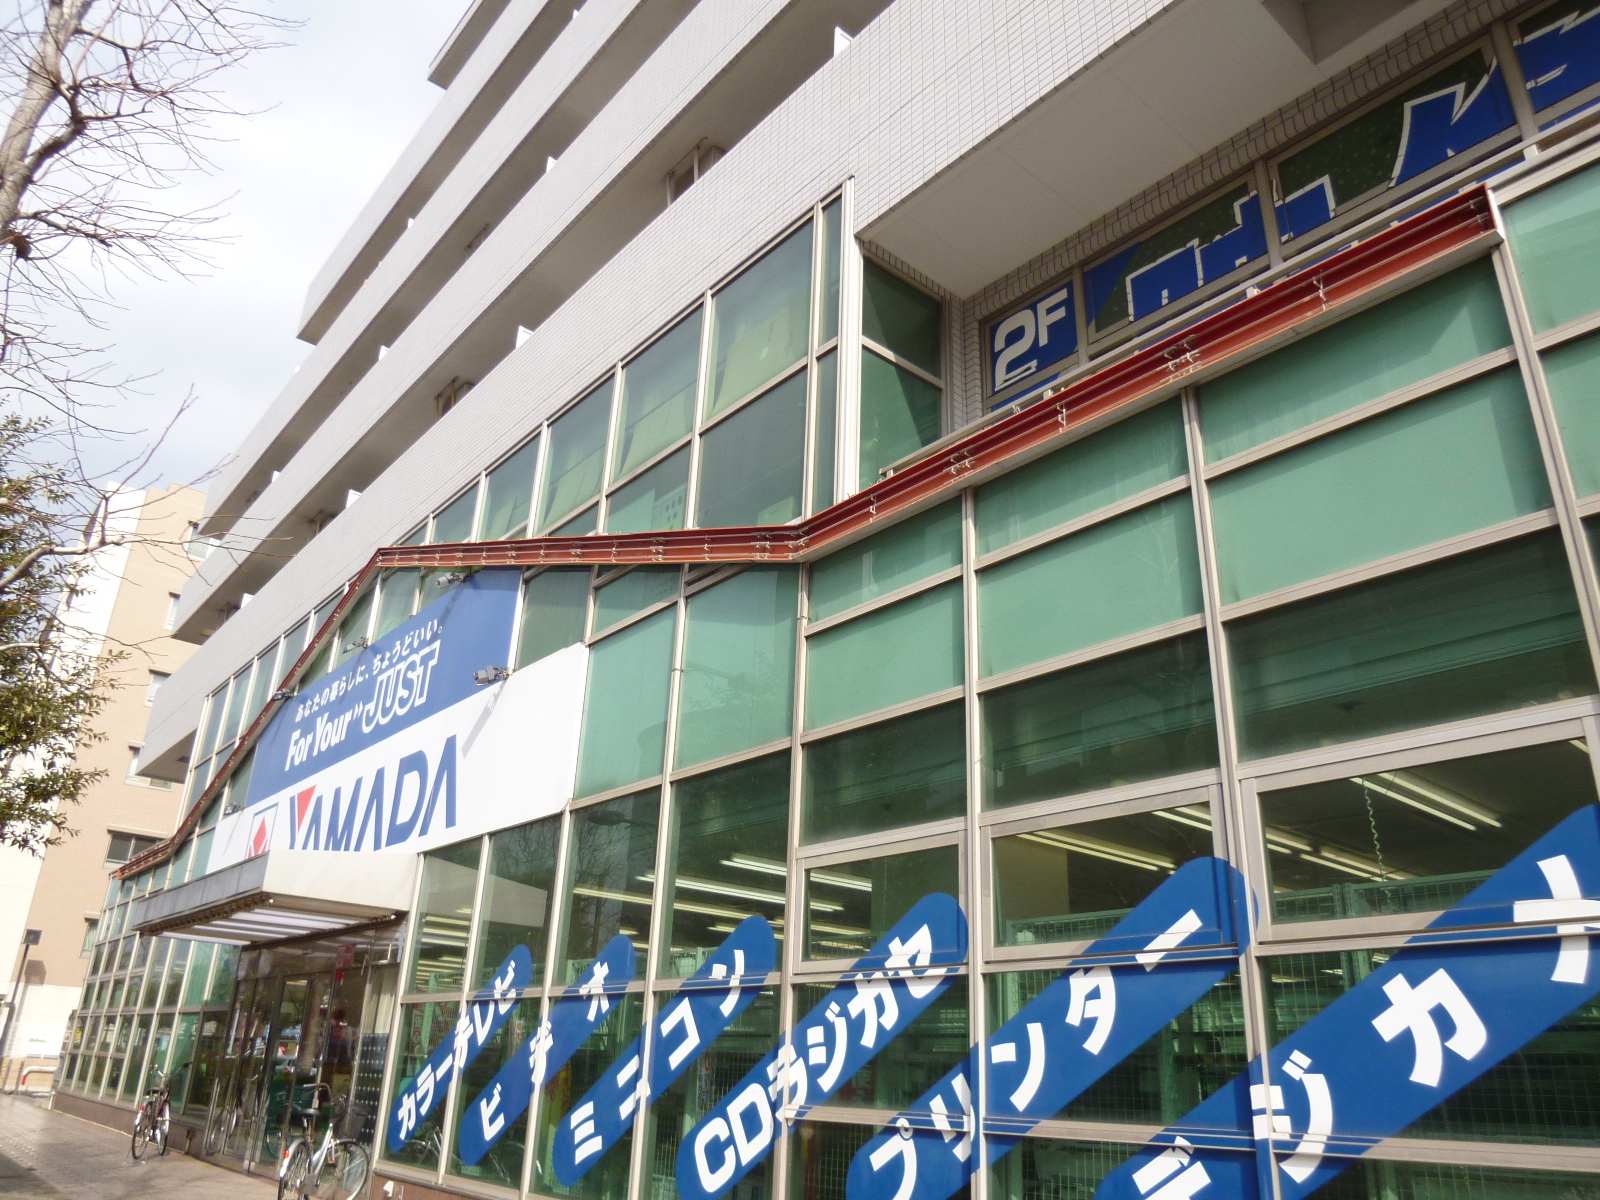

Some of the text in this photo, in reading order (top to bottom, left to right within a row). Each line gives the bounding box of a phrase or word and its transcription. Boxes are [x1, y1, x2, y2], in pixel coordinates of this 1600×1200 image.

[994, 288, 1068, 392] 2F
[285, 640, 441, 772] For Your JUST
[289, 734, 457, 852] YAMADA
[397, 960, 516, 1140] カラーテレビ
[480, 961, 609, 1141] ビデオ
[570, 949, 745, 1165] ミニコン
[869, 909, 1203, 1200] プリンター
